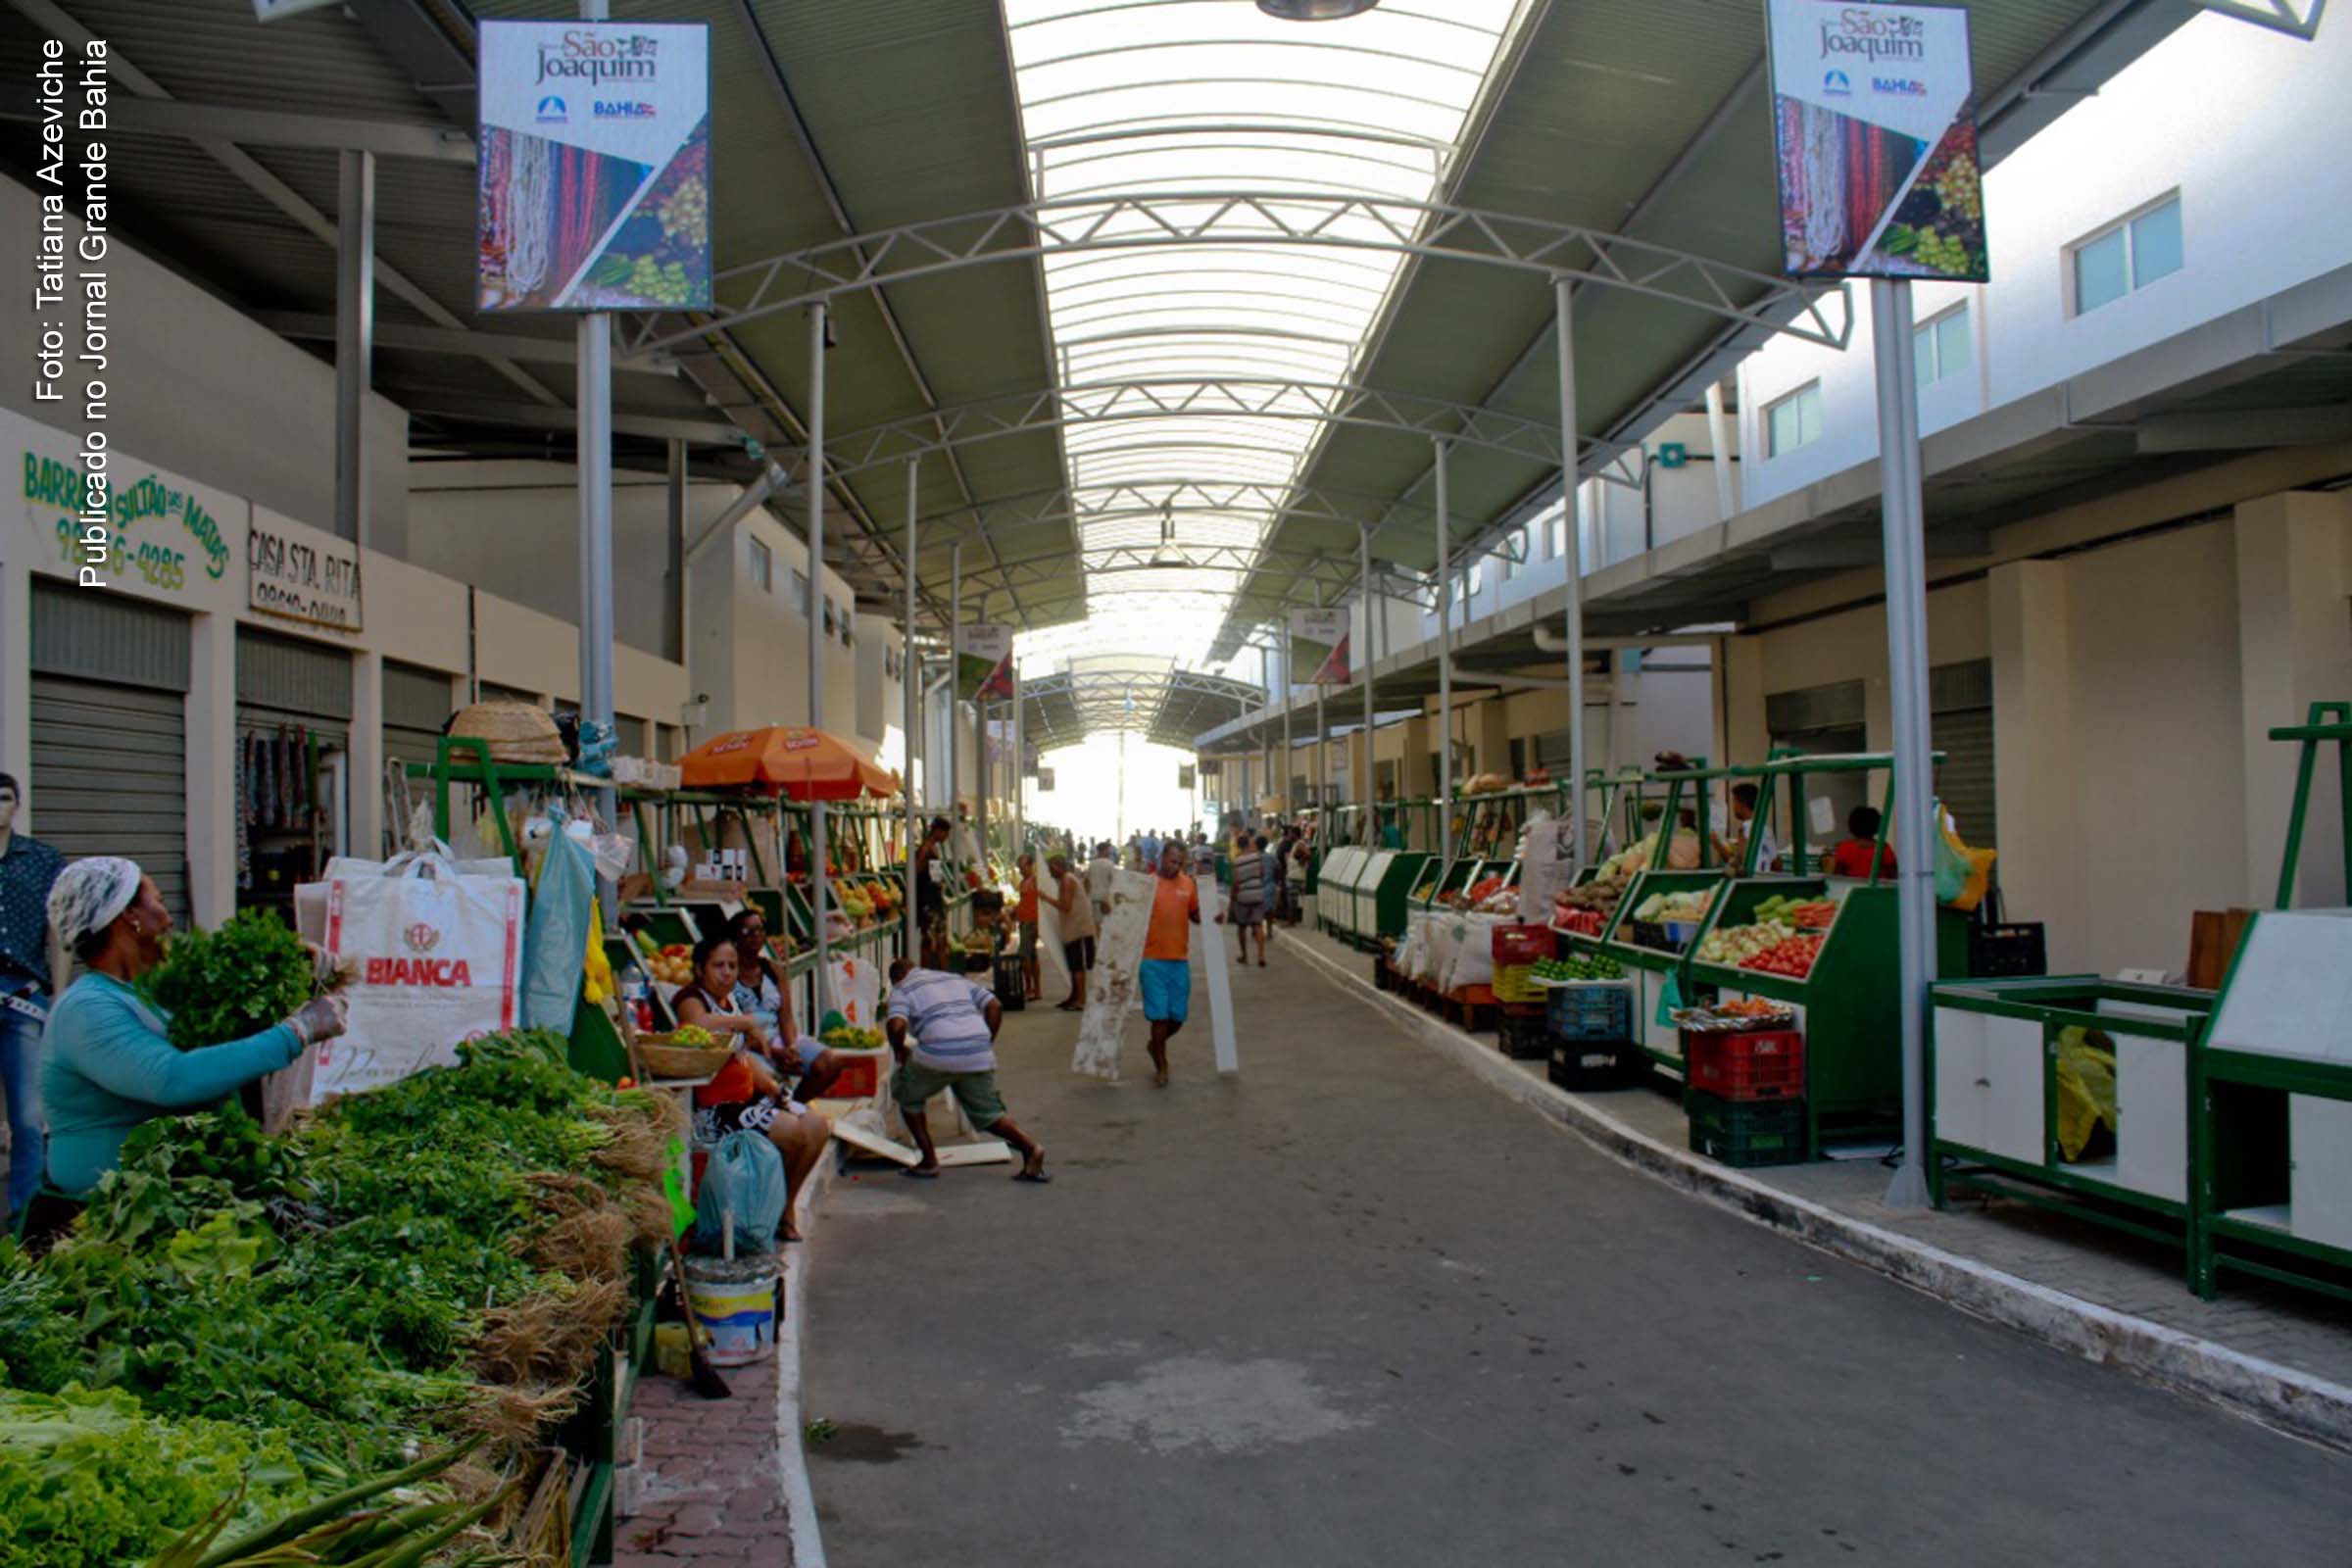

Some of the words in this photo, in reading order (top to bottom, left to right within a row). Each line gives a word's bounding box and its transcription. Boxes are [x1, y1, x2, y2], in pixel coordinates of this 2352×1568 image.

[1840, 8, 1887, 36] São
[564, 30, 616, 58] São
[1820, 21, 1924, 63] Joaquim
[535, 47, 656, 86] Joaquim
[1872, 77, 1919, 94] BAHIA
[594, 100, 645, 117] BAHIA
[24, 452, 114, 523] BARRAA
[55, 517, 186, 590] 986-4285
[248, 529, 285, 578] CASA
[366, 956, 471, 988] BIANCA
